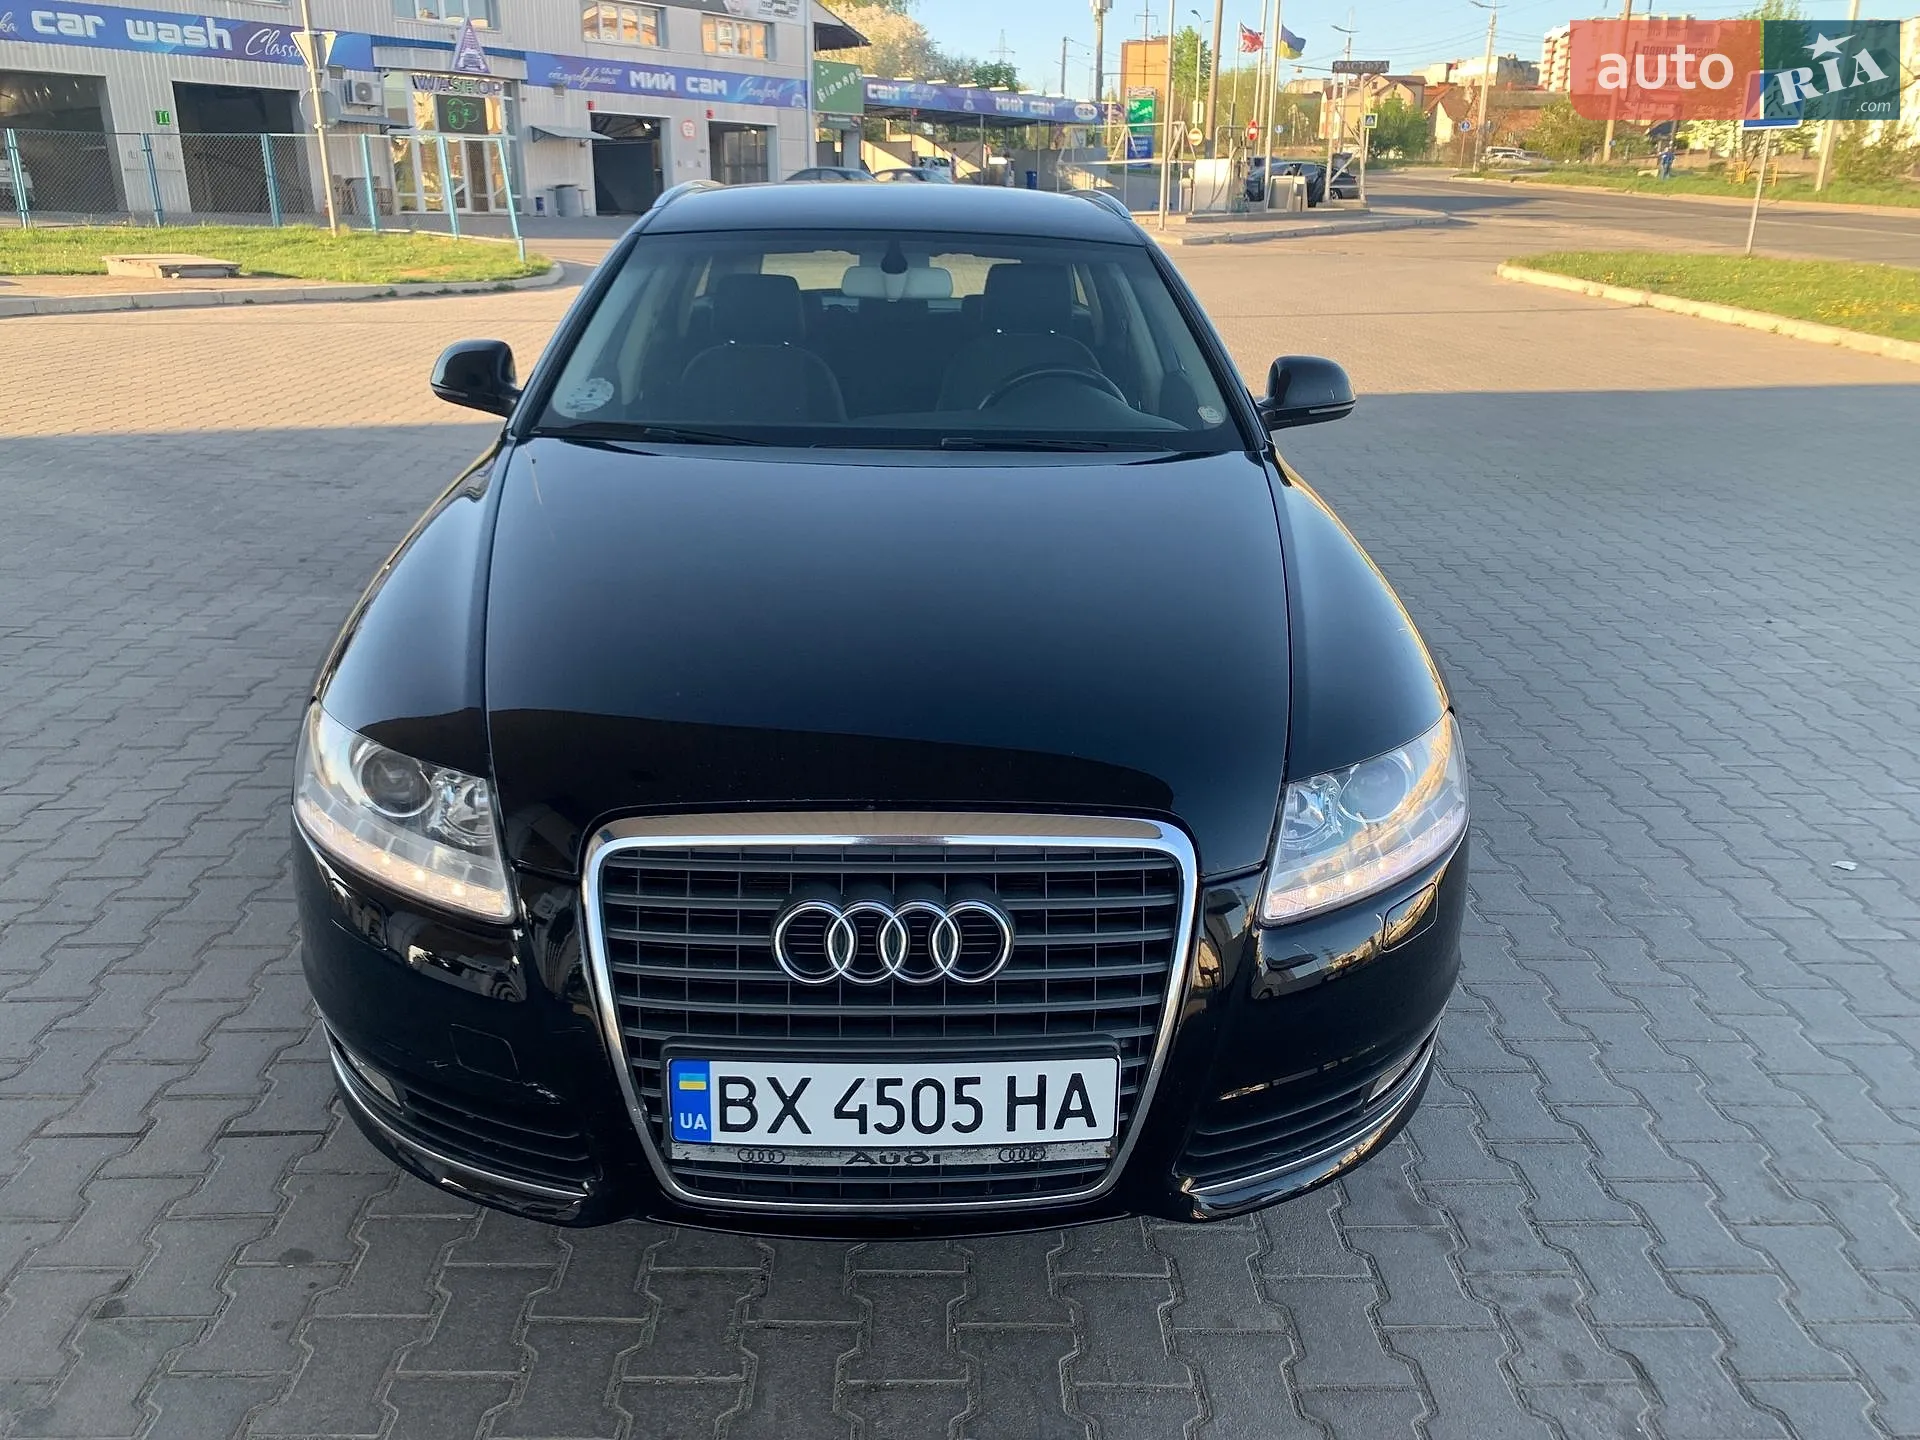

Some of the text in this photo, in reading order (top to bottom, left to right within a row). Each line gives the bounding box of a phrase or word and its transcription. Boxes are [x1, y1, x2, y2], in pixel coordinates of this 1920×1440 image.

[31, 10, 233, 51] car wash
[245, 28, 303, 58] Classi
[718, 1072, 1098, 1135] BX 4505 HA
[679, 1113, 707, 1131] UA
[845, 1150, 941, 1166] Audi
